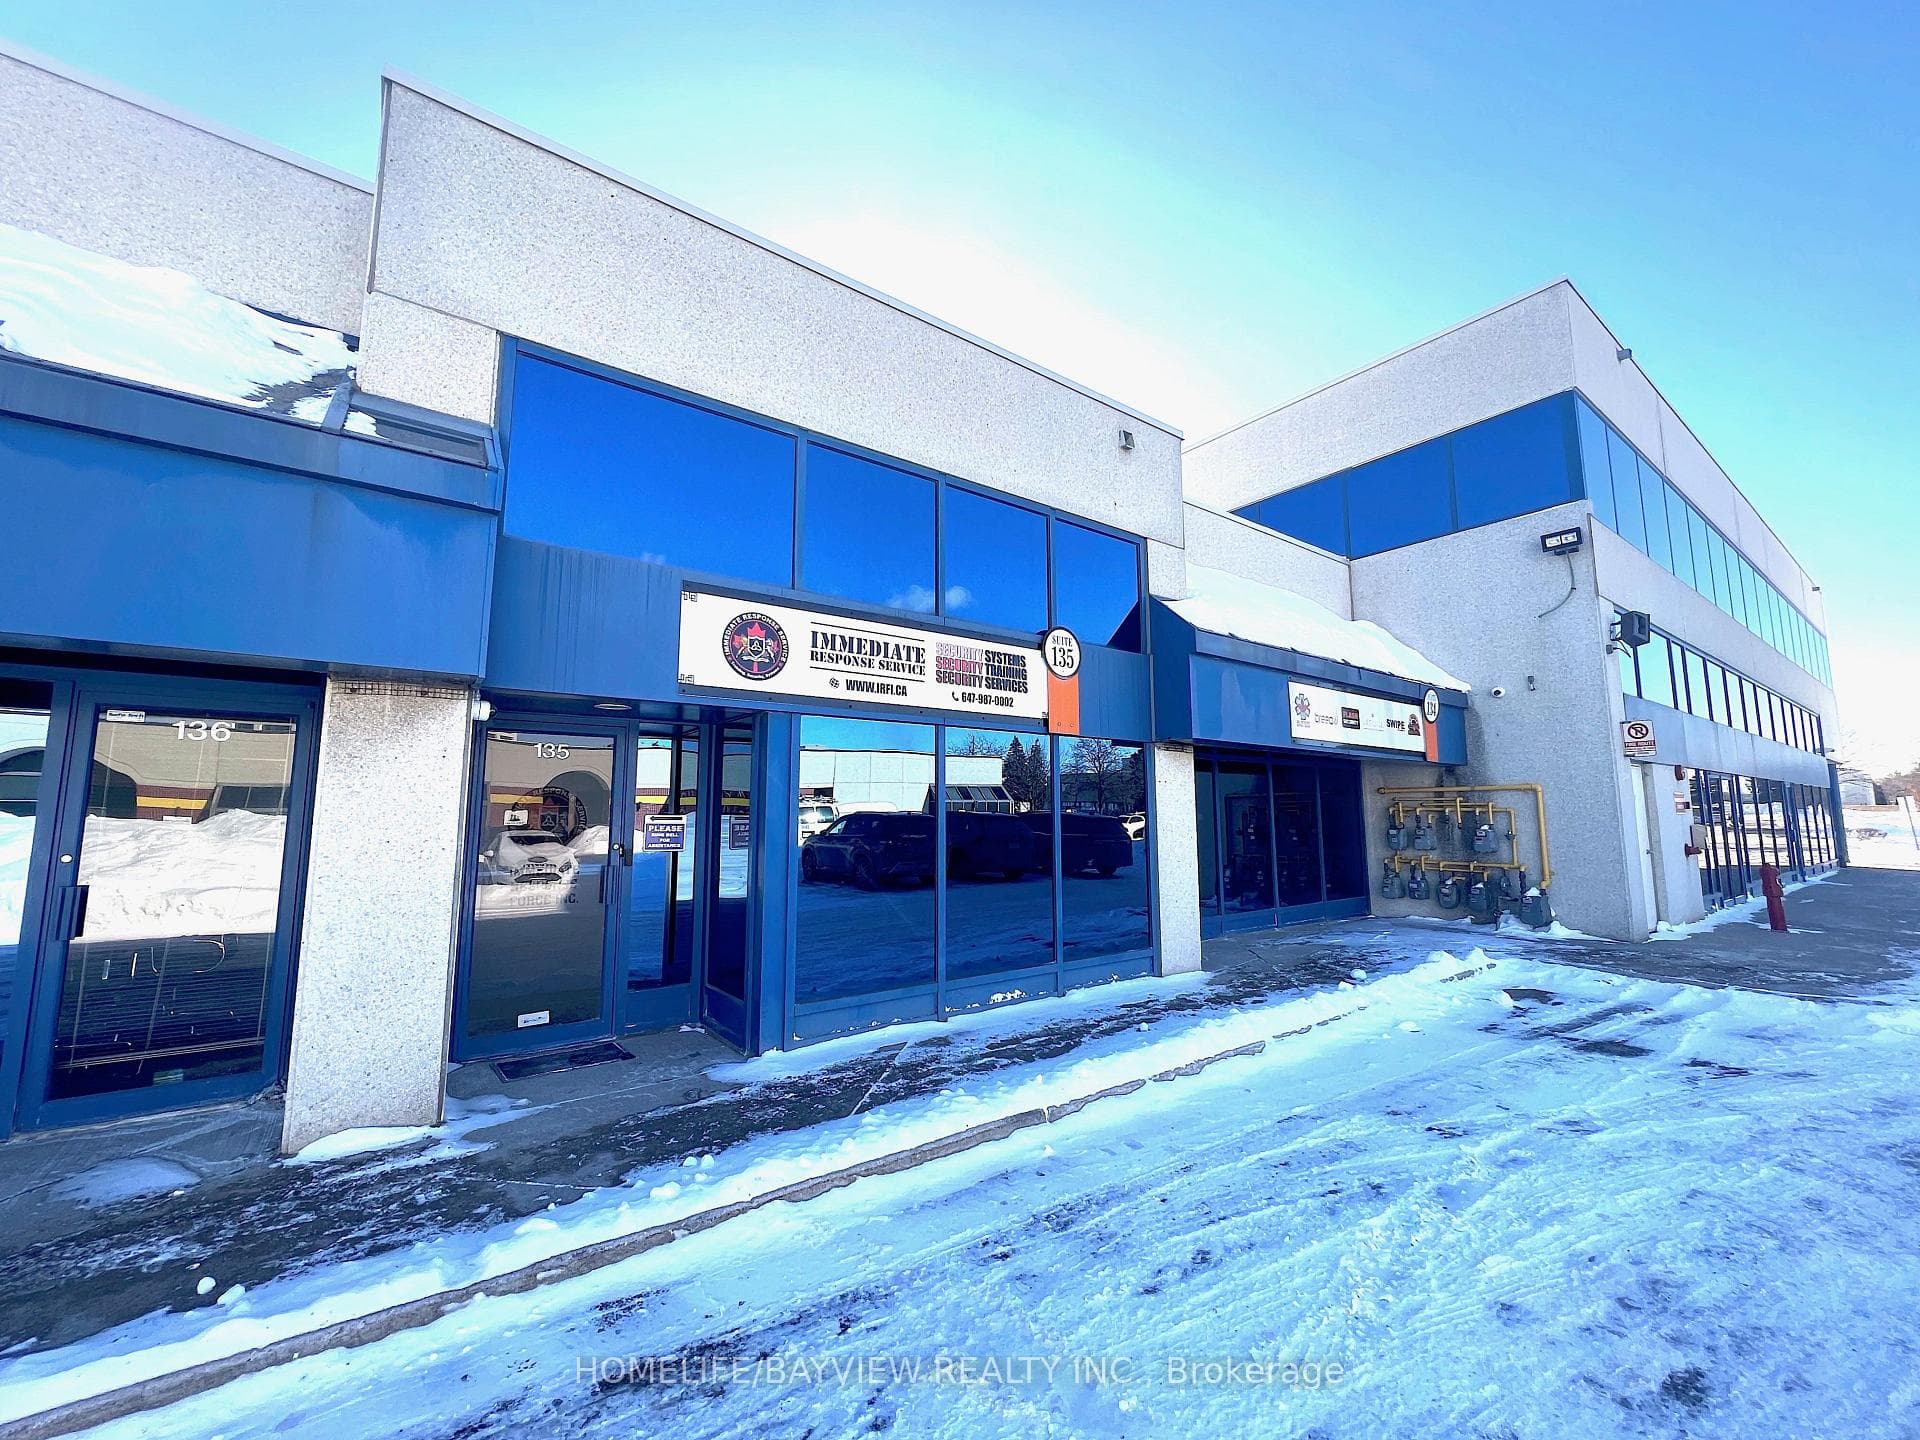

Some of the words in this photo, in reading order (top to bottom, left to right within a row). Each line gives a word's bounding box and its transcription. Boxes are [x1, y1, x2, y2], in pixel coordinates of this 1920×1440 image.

[811, 630, 926, 664] IMMEDIATE
[1051, 635, 1073, 648] SUITE
[810, 650, 875, 669] RESPONSE
[878, 659, 926, 676] SERVICE
[935, 642, 984, 662] SECURITY
[984, 649, 1027, 667] SYSTEMS
[1051, 646, 1075, 669] 135
[935, 655, 984, 674] SECURITY
[984, 662, 1028, 681] TRAINING
[845, 678, 908, 697] WWW.IRFI.CA
[935, 669, 984, 689] SECURITY
[984, 676, 1029, 694] SERVICES
[961, 691, 1014, 708] 647-987-0002
[171, 720, 231, 742] 136
[533, 742, 570, 759] 135
